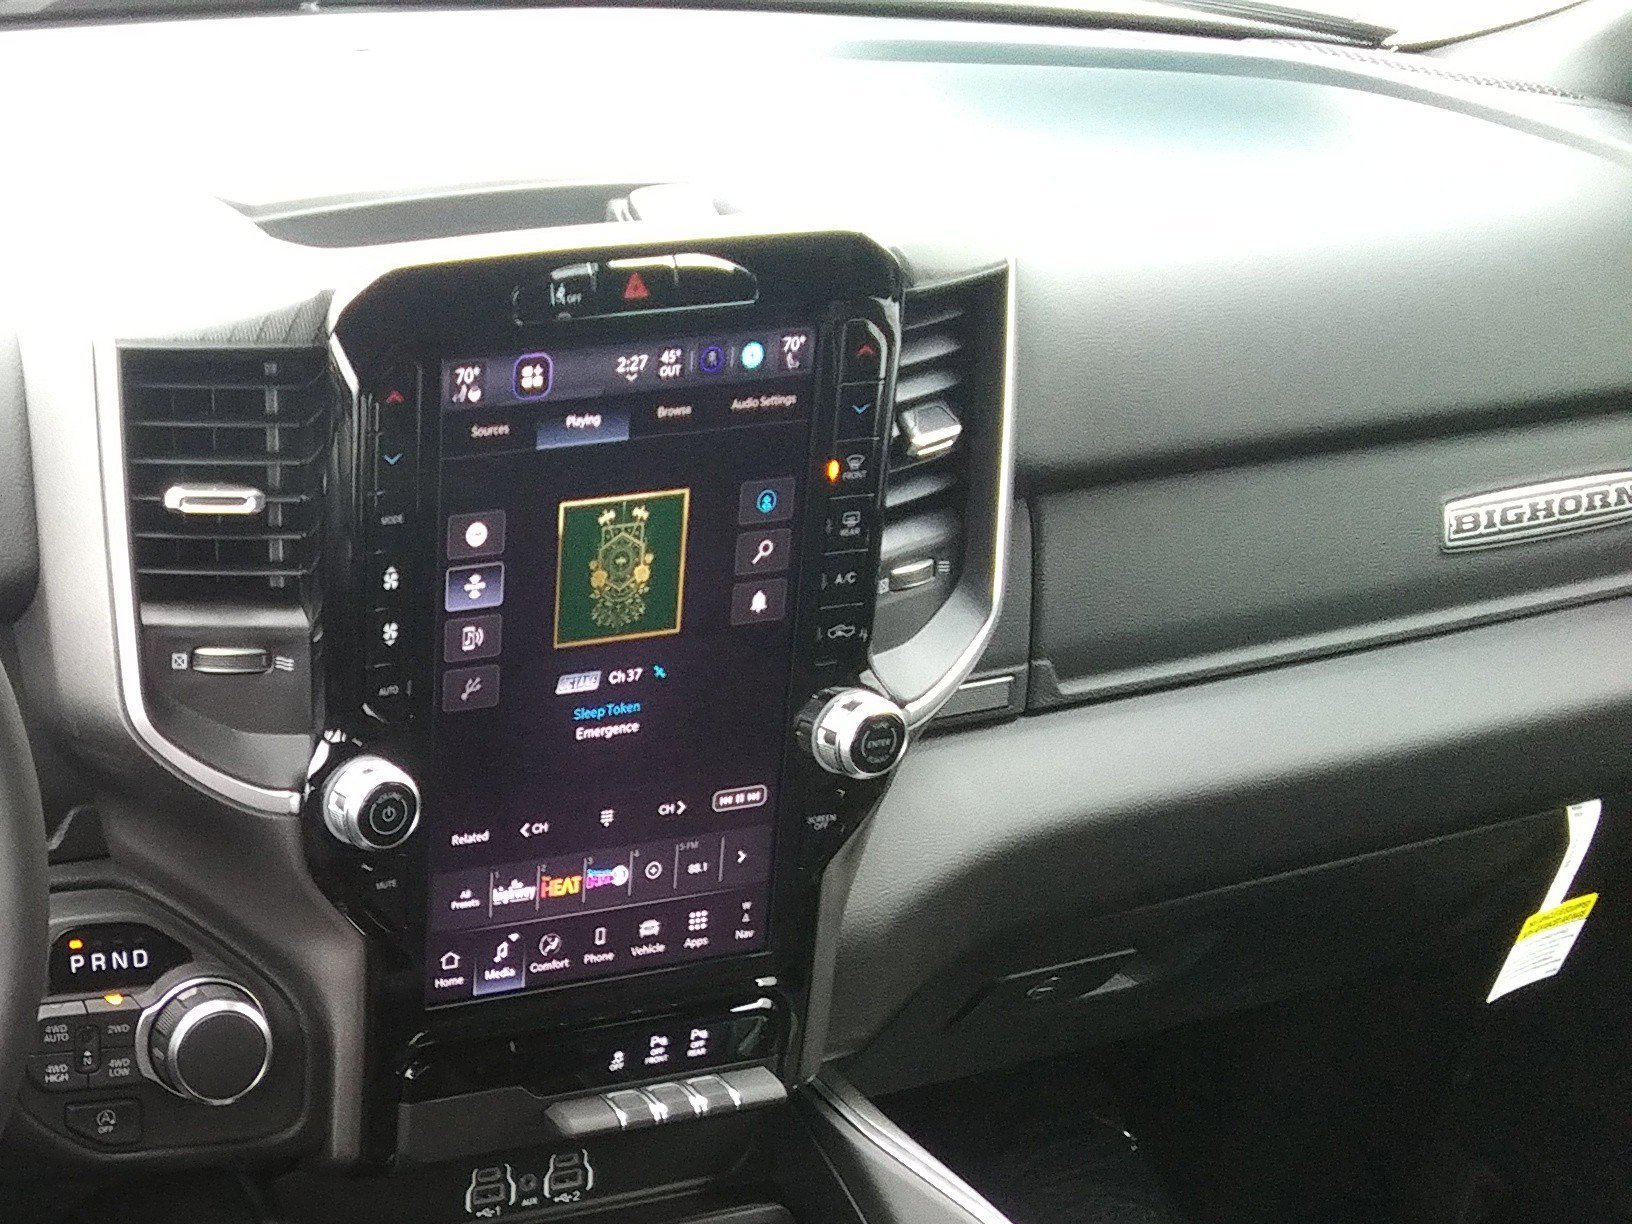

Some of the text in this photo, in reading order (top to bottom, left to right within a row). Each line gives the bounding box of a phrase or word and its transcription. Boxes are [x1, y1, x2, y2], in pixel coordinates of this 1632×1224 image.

[617, 354, 649, 373] 2:27
[659, 364, 682, 378] OUT
[731, 394, 797, 411] Audio Settings
[657, 405, 692, 419] Browse
[565, 412, 602, 428] Playing
[471, 423, 510, 438] Sources
[835, 572, 857, 585] A/C
[608, 670, 626, 684] Ch
[627, 667, 643, 682] 37
[379, 685, 399, 696] AUTO
[574, 702, 641, 720] Sleep Token
[575, 722, 640, 740] Emergence
[658, 803, 675, 815] CH
[532, 822, 548, 834] CH
[451, 830, 490, 846] Related
[541, 876, 582, 898] HEAT
[735, 929, 756, 940] Nav
[631, 943, 666, 957] Vehicle
[683, 937, 710, 950] Apps
[583, 951, 615, 965] Phone
[529, 958, 570, 974] Comfort
[484, 967, 516, 981] Media
[434, 976, 465, 989] Home
[45, 1025, 68, 1034] 4WD
[107, 1024, 130, 1034] 2WD
[43, 1033, 69, 1043] AUTO
[45, 1064, 68, 1074] 4WD
[108, 1058, 130, 1068] 4WD
[45, 1072, 69, 1083] HIGH
[108, 1067, 130, 1077] LOW
